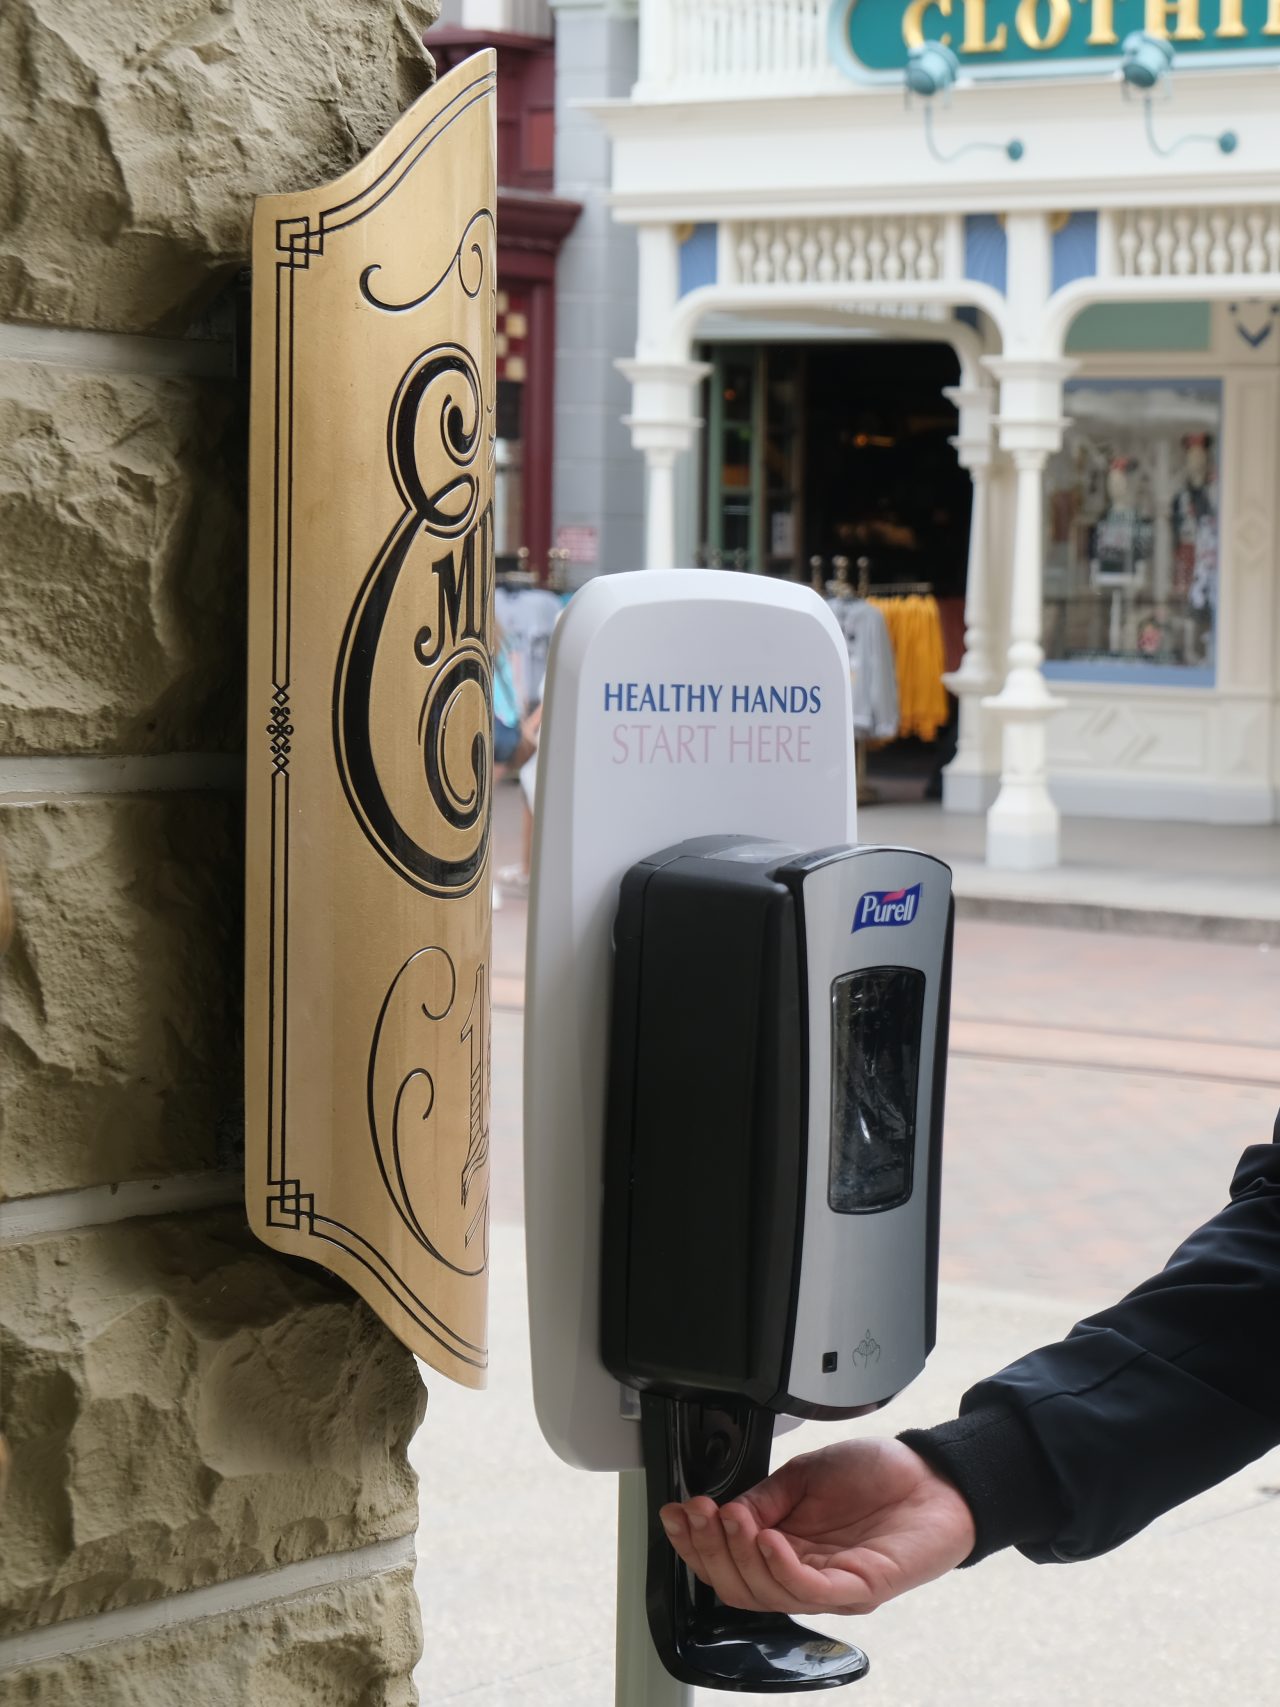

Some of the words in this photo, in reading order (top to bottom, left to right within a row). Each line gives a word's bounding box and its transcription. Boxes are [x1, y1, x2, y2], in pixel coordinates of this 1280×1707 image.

[603, 683, 723, 713] HEALTHY
[731, 685, 822, 714] HANDS
[611, 723, 717, 765] START
[729, 725, 813, 764] HERE
[860, 894, 916, 924] Purell
